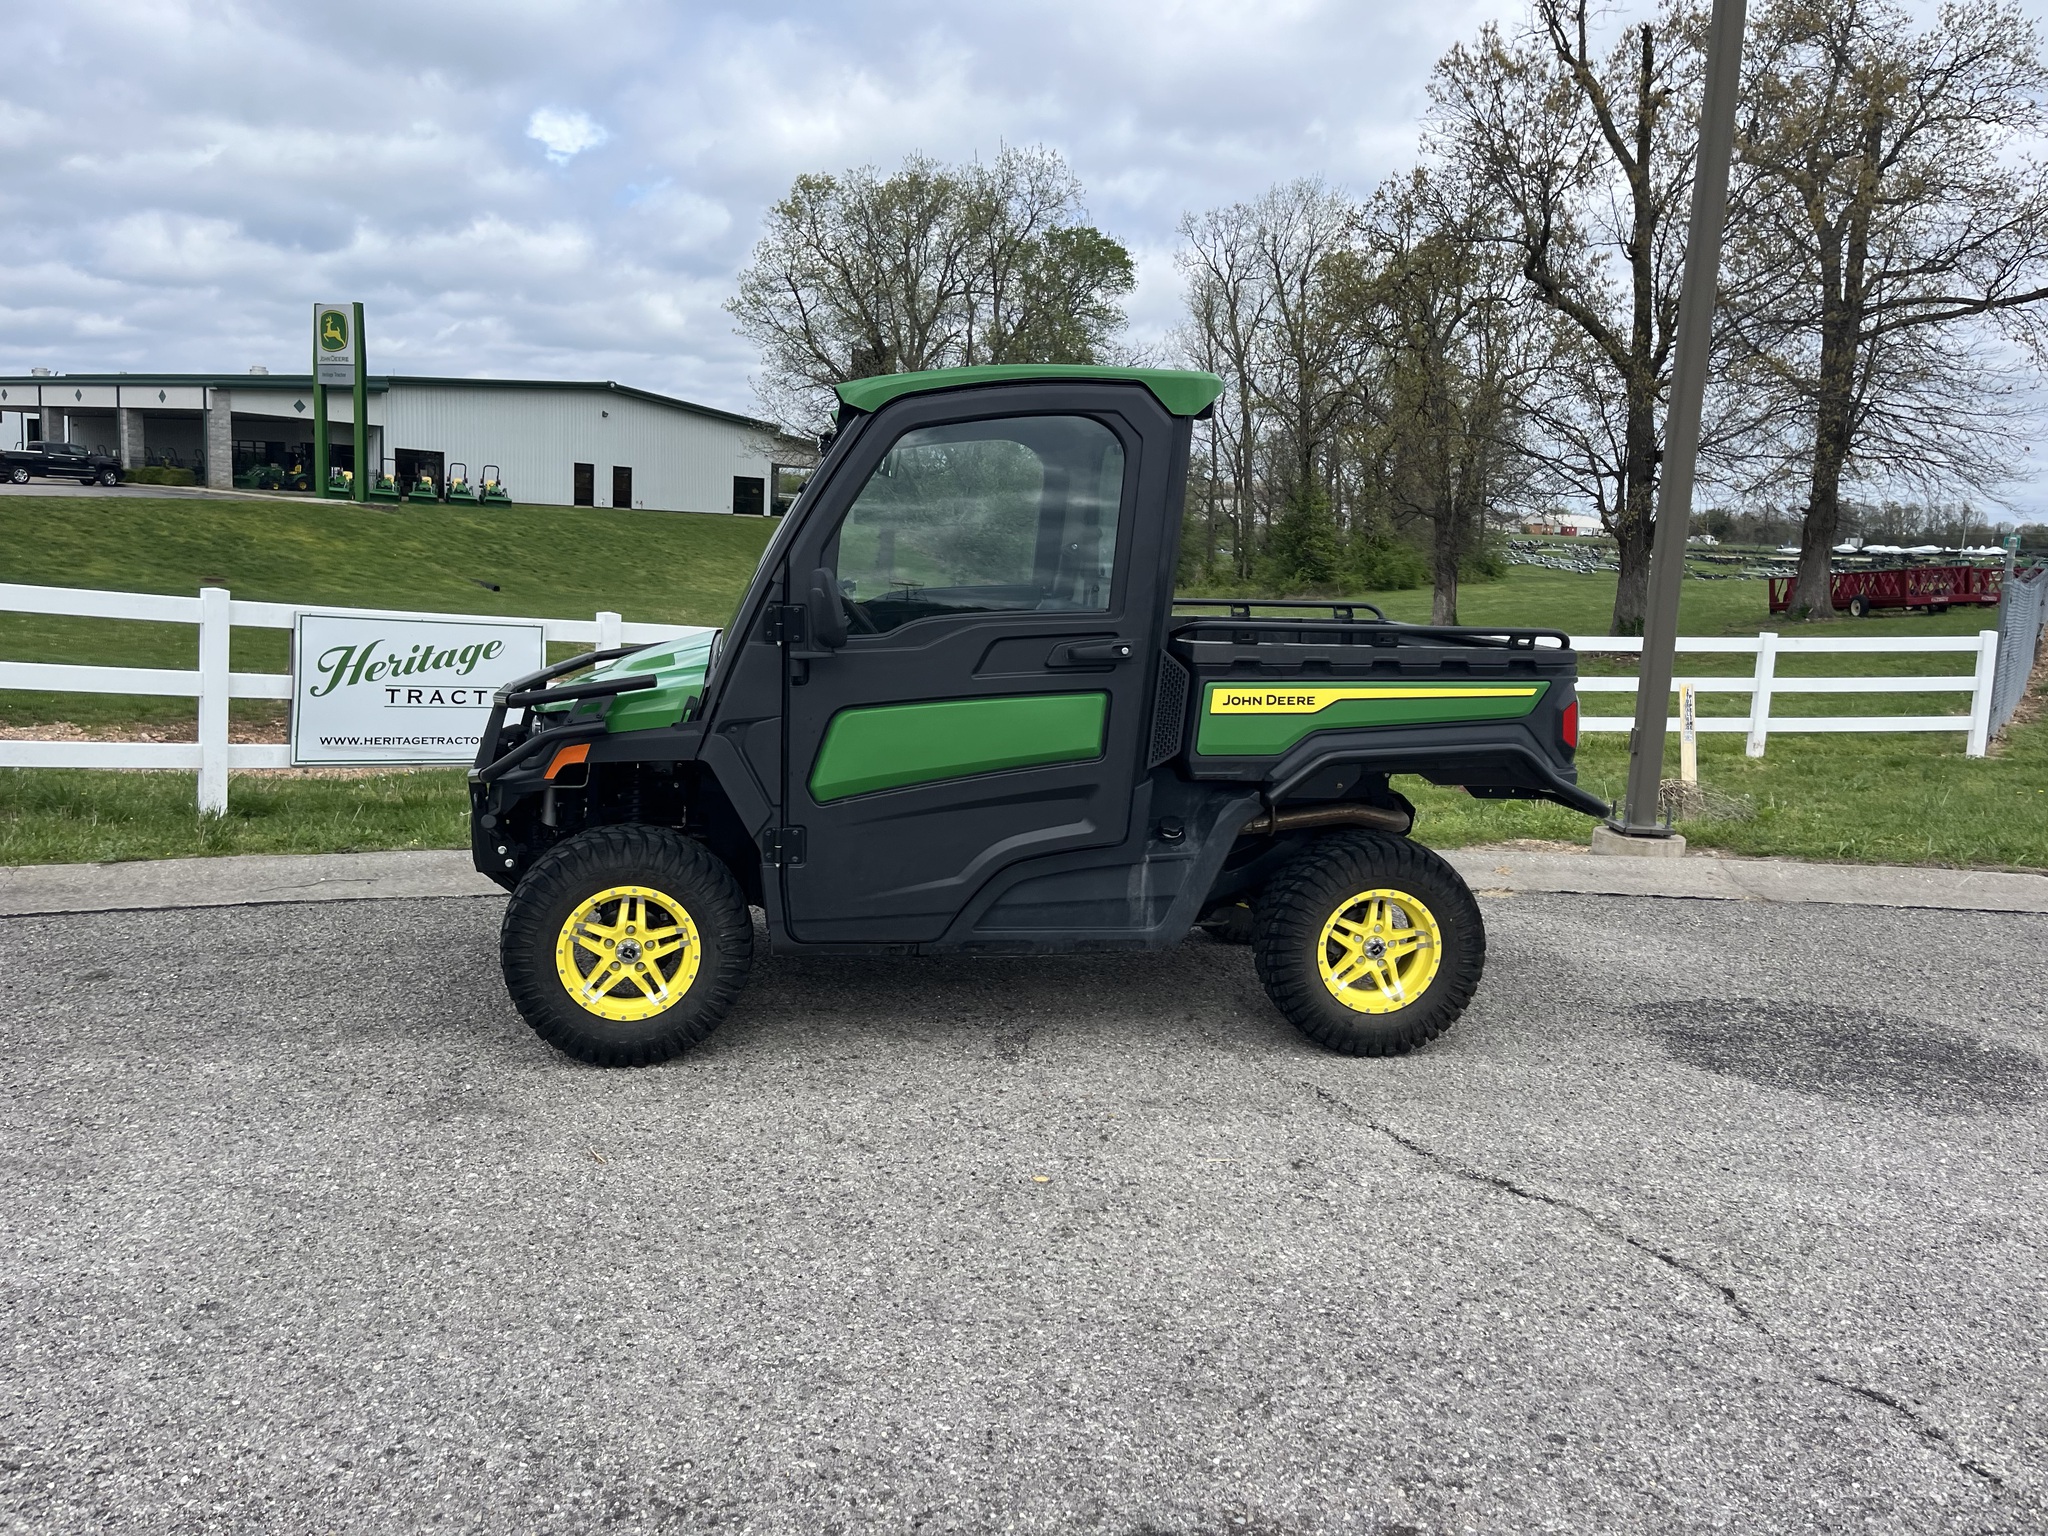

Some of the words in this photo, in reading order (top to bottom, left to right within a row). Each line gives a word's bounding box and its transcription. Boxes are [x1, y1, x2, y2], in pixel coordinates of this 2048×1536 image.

[310, 639, 506, 697] Heritage
[385, 688, 488, 705] TRACT
[1223, 695, 1262, 705] JOHN
[1266, 695, 1315, 705] DEERE
[319, 736, 483, 746] WWW.HERITAGETRACTO
